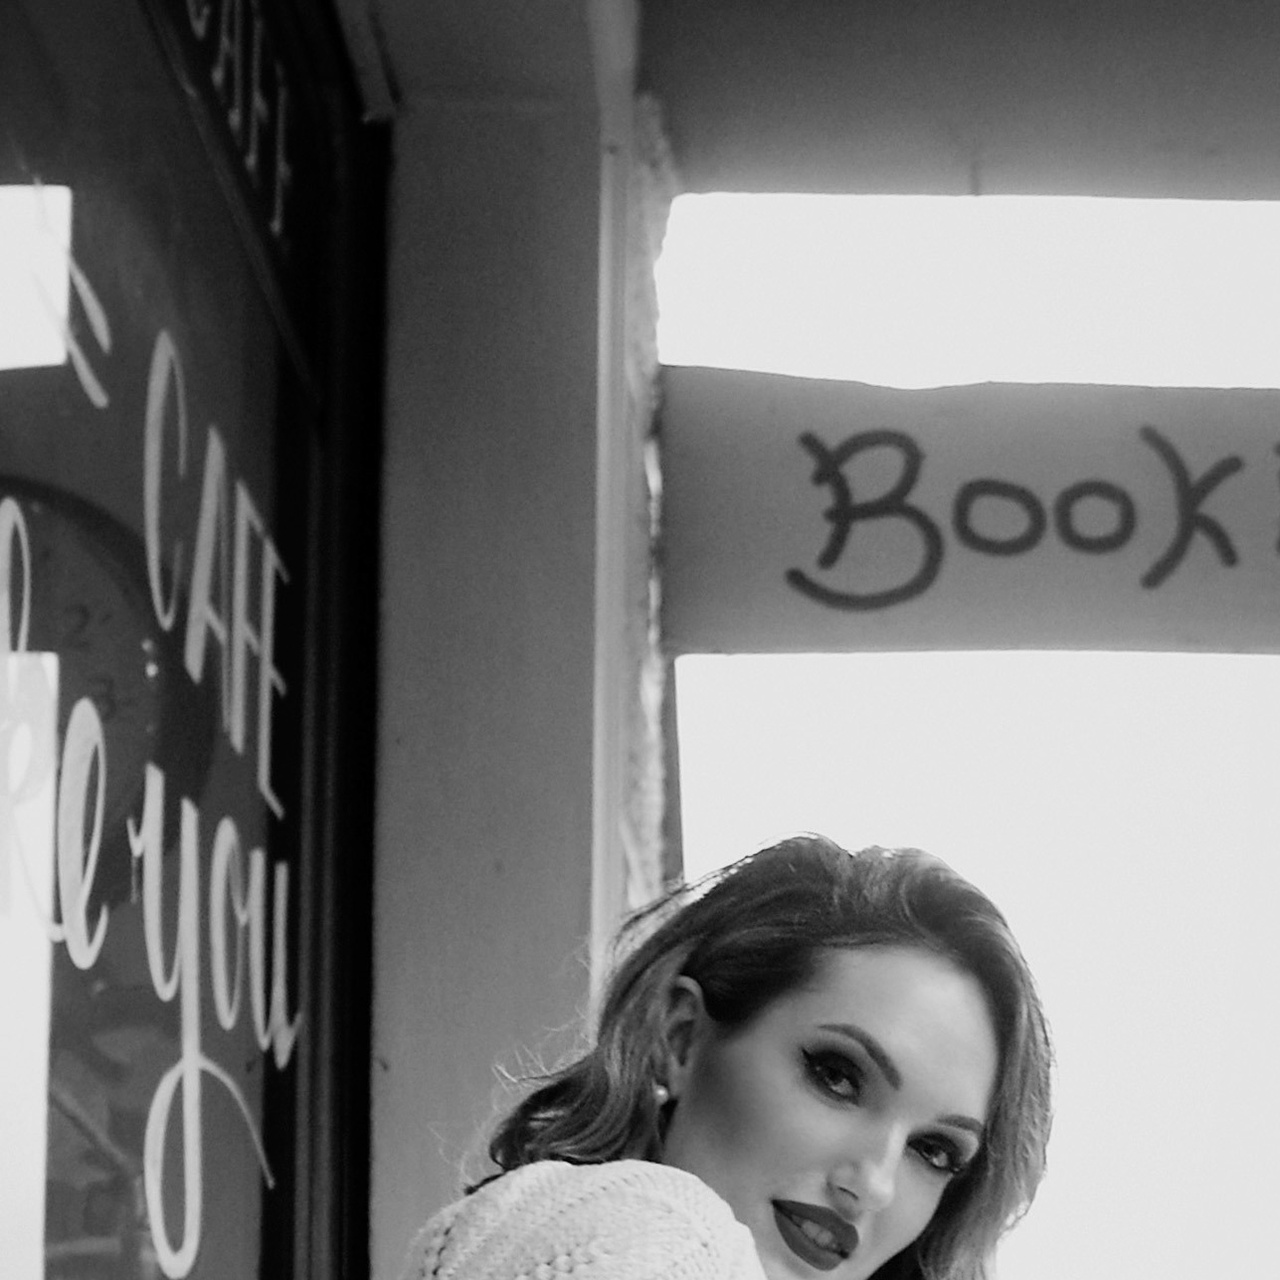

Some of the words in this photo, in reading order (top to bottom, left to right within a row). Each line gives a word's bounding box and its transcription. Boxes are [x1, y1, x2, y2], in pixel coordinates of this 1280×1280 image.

[187, 0, 293, 240] AFE
[143, 329, 291, 818] CAFE
[127, 761, 303, 1280] you
